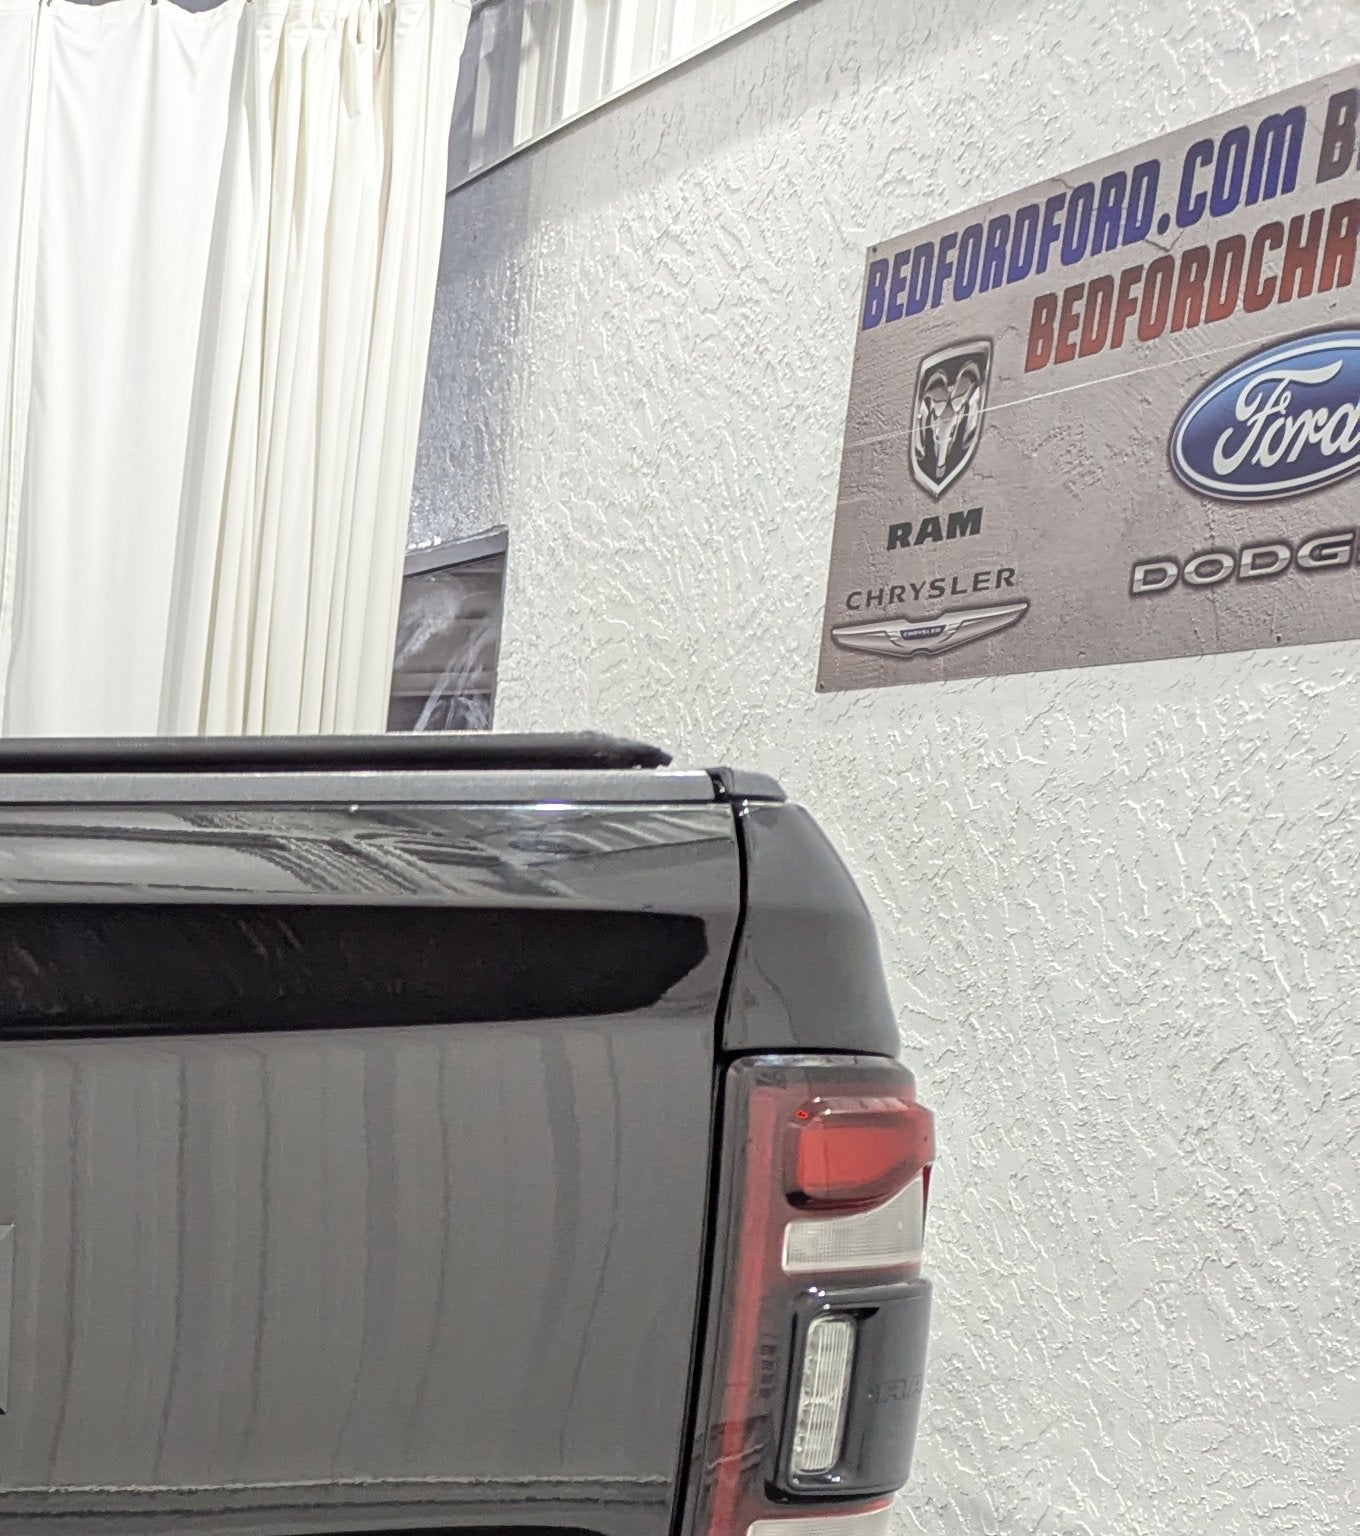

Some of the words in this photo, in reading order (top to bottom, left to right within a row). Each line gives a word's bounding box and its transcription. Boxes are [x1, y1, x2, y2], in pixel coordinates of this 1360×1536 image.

[862, 105, 1307, 331] BEDFORDFORD.COM
[1316, 87, 1360, 184] B
[886, 507, 983, 551] RAM
[846, 567, 1016, 610] CHRYSLER
